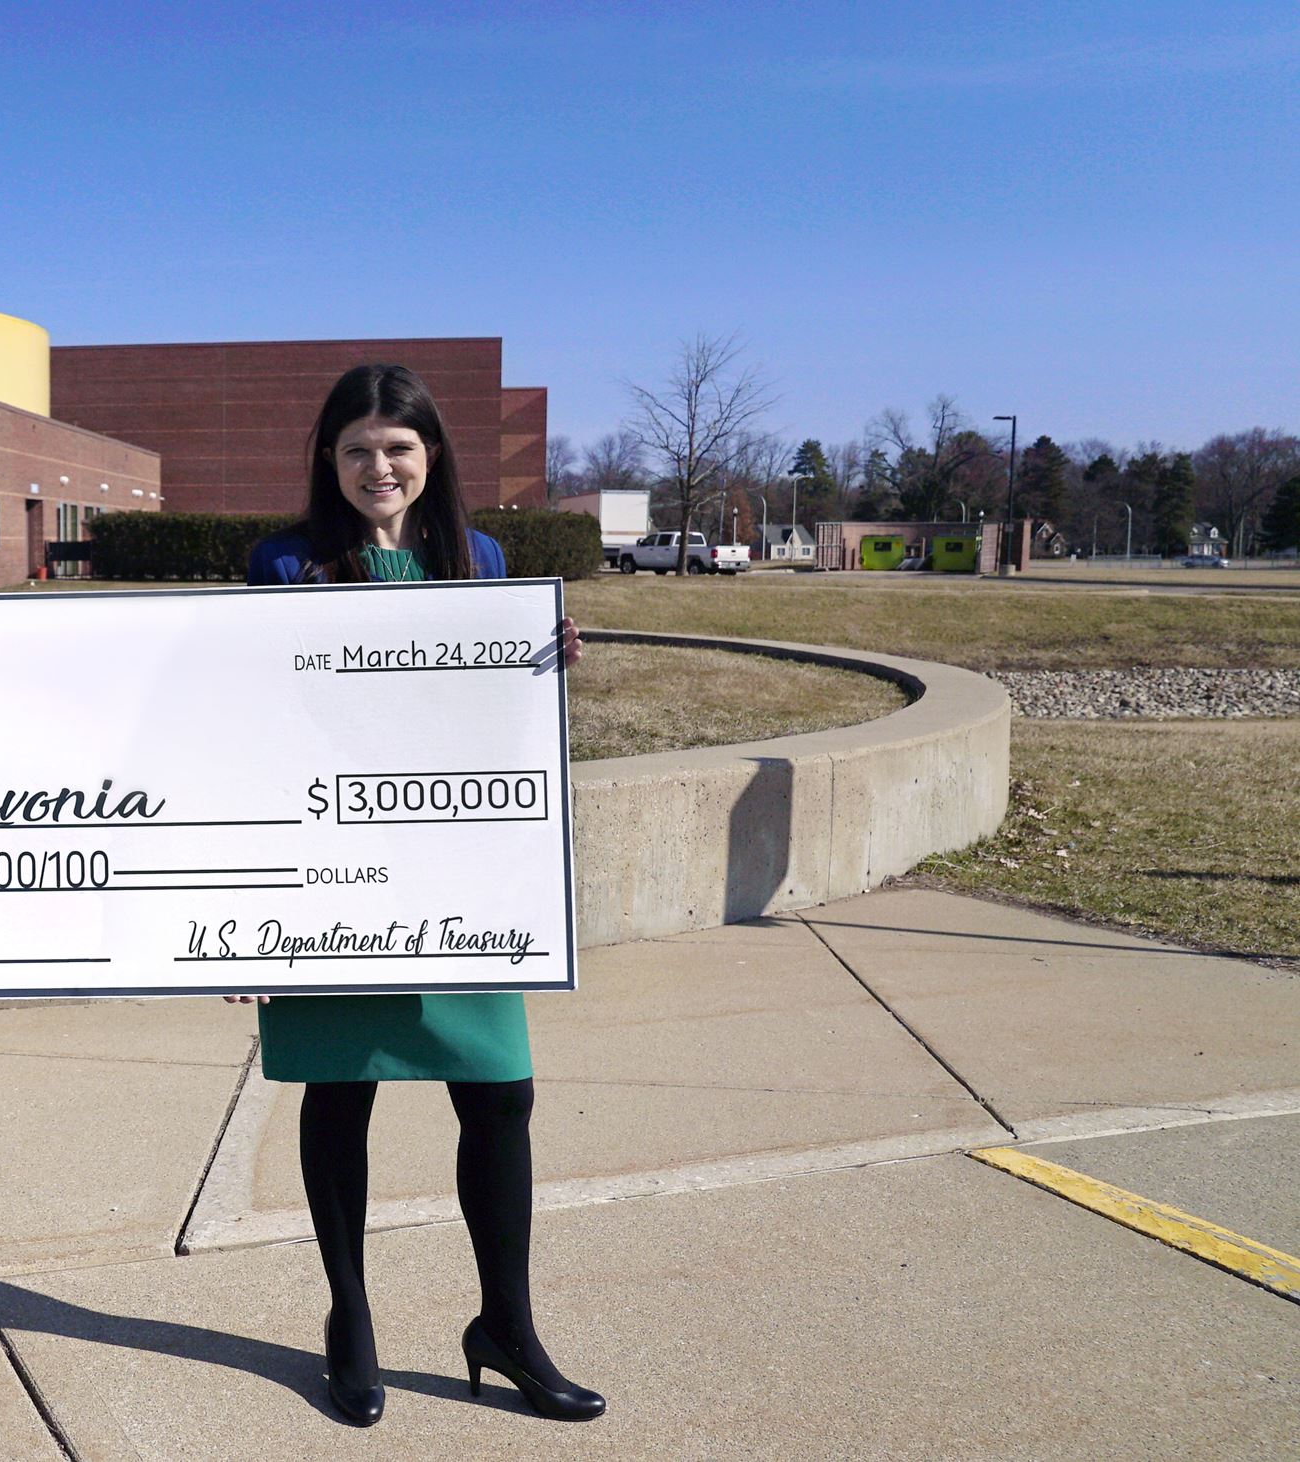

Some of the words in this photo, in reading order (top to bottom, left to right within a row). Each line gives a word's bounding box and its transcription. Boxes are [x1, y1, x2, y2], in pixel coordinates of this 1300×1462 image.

[294, 654, 332, 671] DATE
[343, 640, 426, 668] March
[348, 777, 536, 819] 3,000,000
[306, 866, 389, 884] DOLLARS
[188, 920, 208, 960] U.
[217, 919, 237, 958] S.
[257, 919, 398, 968] Department
[404, 919, 428, 953] of
[438, 916, 534, 965] Treasury
